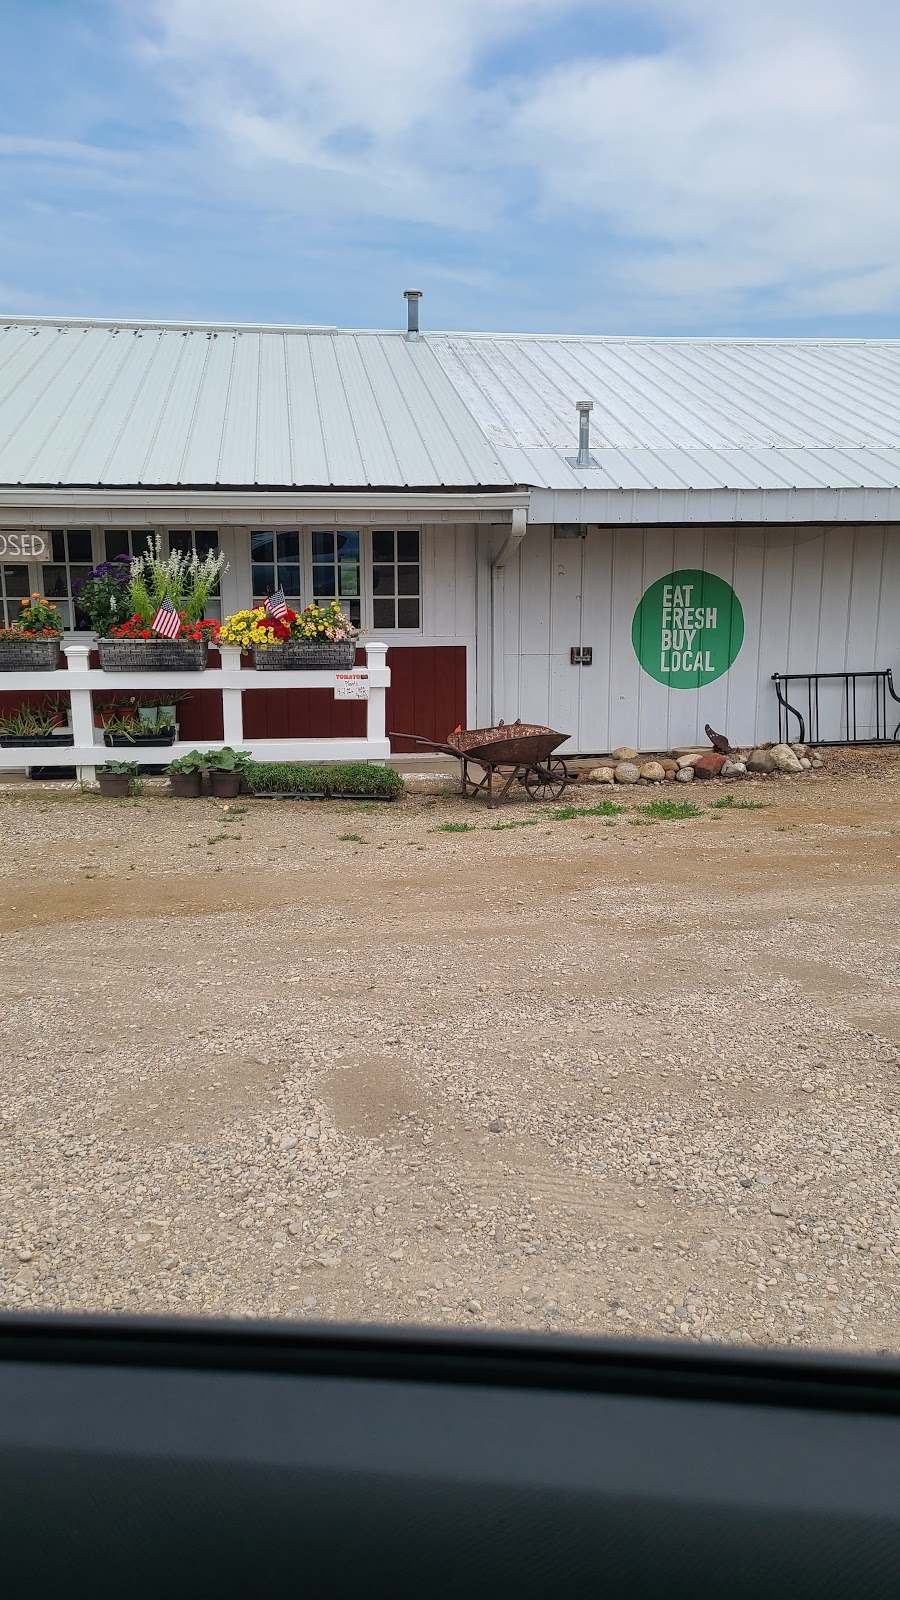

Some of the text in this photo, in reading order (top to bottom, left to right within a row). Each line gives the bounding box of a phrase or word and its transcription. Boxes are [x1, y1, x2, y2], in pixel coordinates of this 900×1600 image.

[663, 585, 694, 607] EAT
[662, 607, 717, 630] FRESH
[661, 629, 697, 651] BUY
[660, 650, 715, 672] LOCAL
